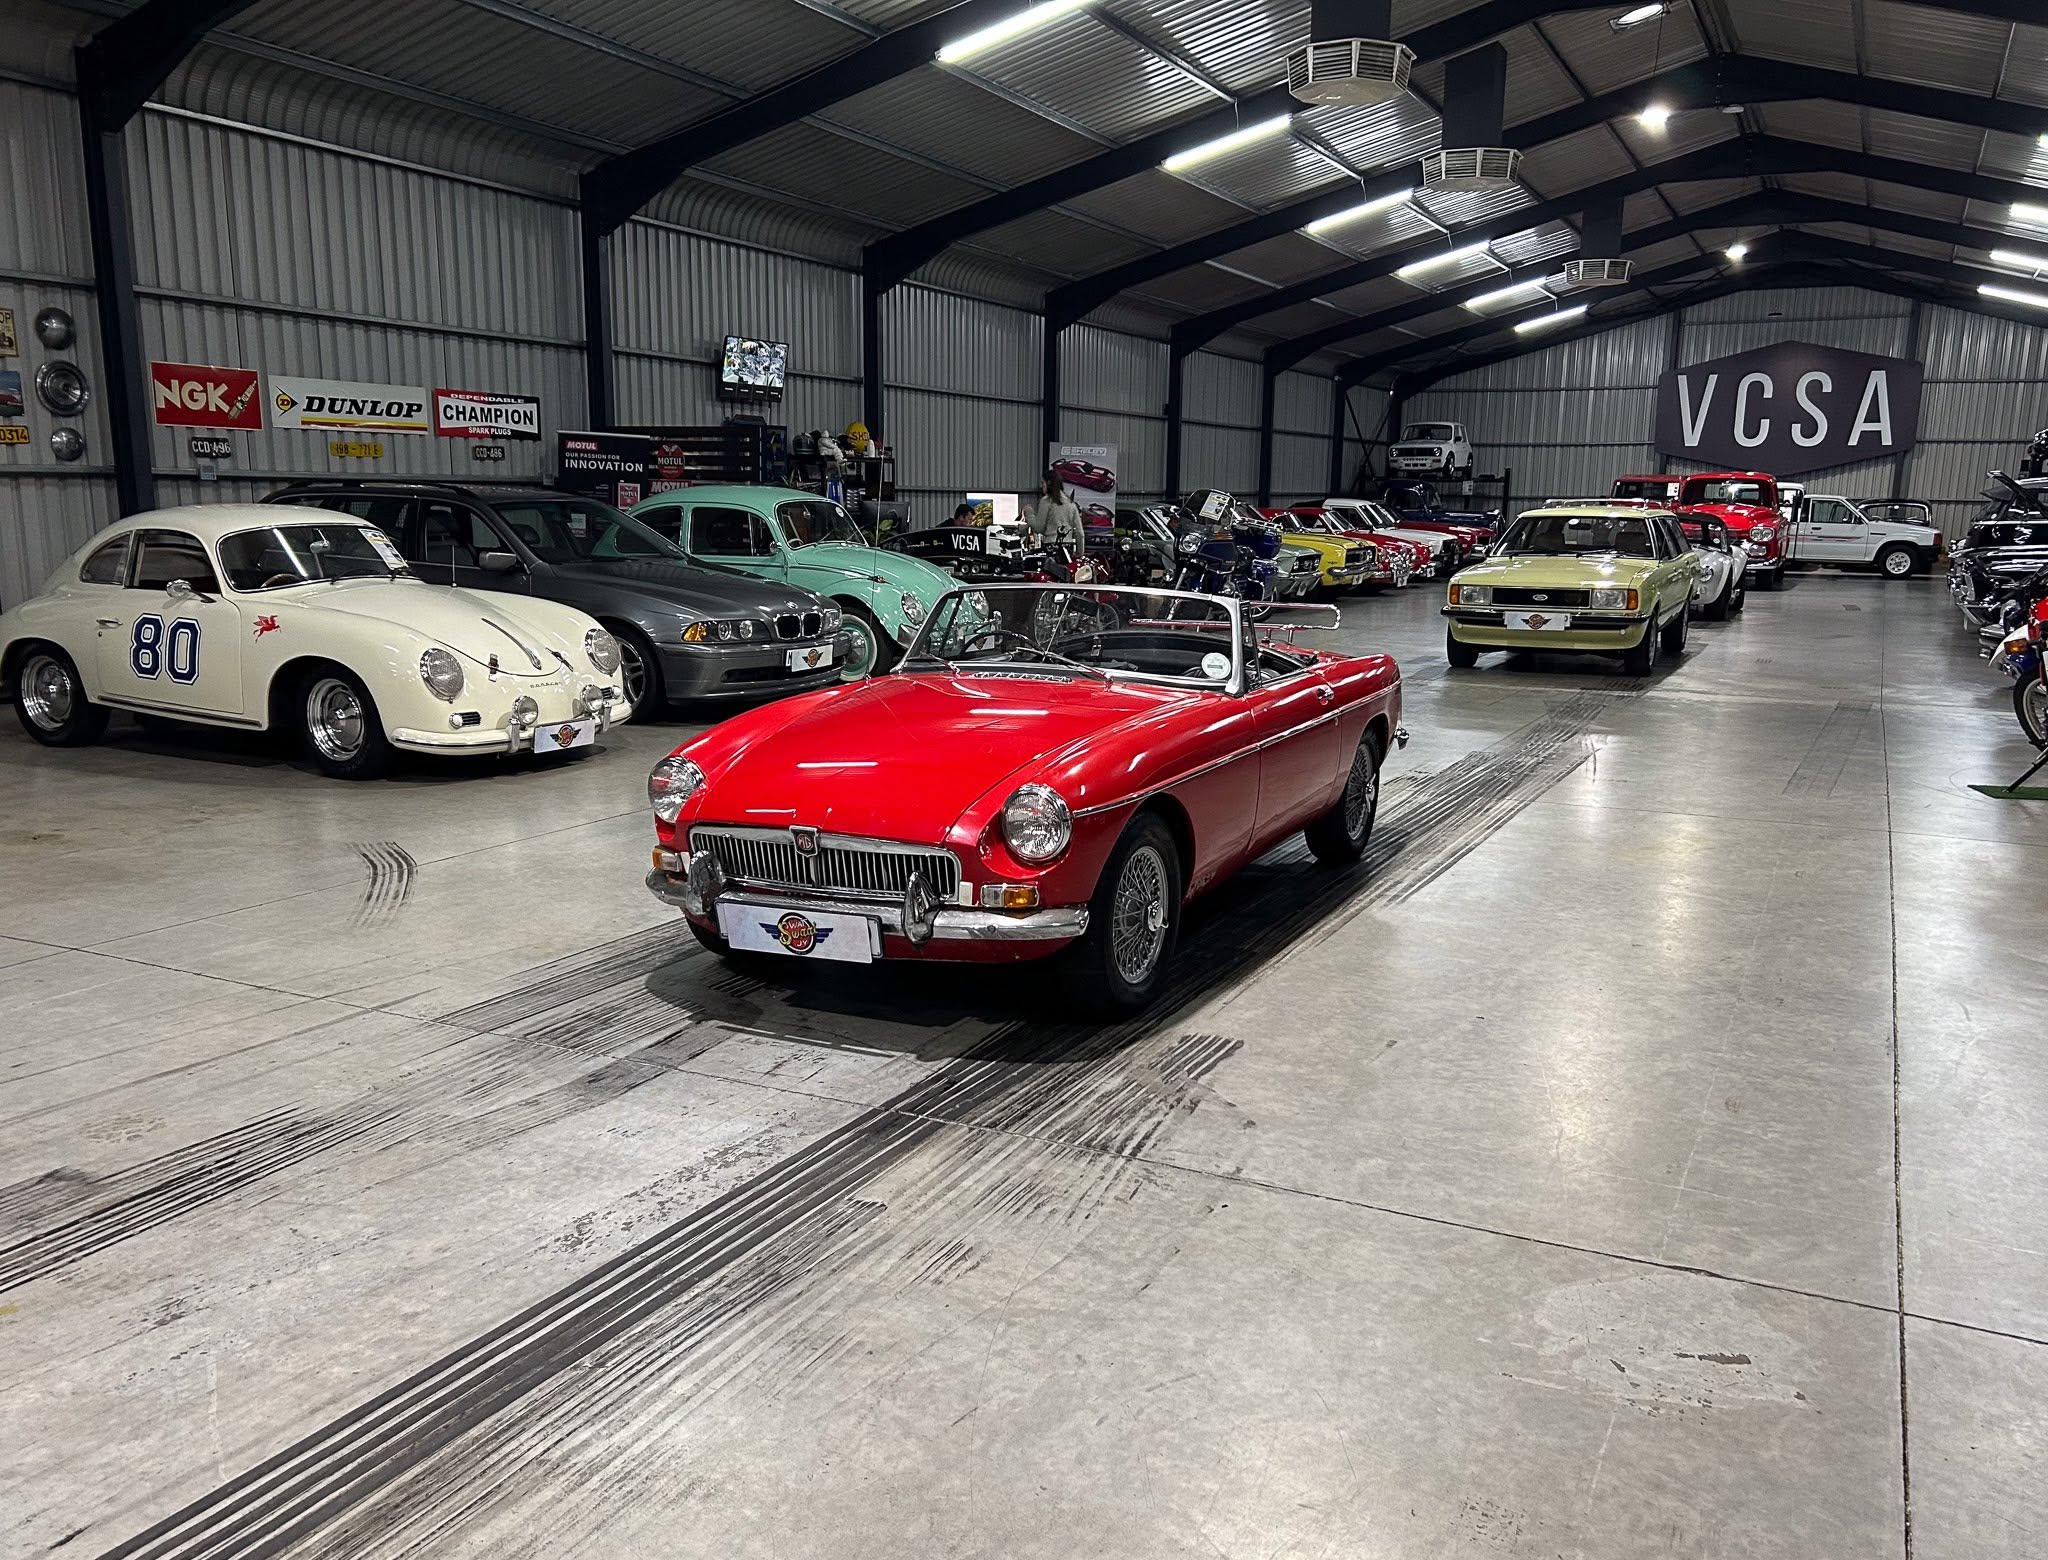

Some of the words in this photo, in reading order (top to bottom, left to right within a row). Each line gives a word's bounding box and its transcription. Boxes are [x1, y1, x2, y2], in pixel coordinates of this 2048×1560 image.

[154, 379, 231, 413] NGK
[450, 393, 525, 404] DEPENDABLE
[302, 396, 423, 418] DUNLOP
[1677, 370, 1893, 447] VCSA
[443, 404, 534, 426] CHAMPION
[468, 427, 490, 435] SPARK
[490, 427, 512, 436] PLUGS
[567, 441, 597, 450] MOTUL
[565, 459, 643, 472] INNOVATION
[657, 457, 684, 465] MOTUL
[951, 534, 980, 551] VCSA
[130, 612, 202, 686] 80
[799, 836, 812, 849] MG
